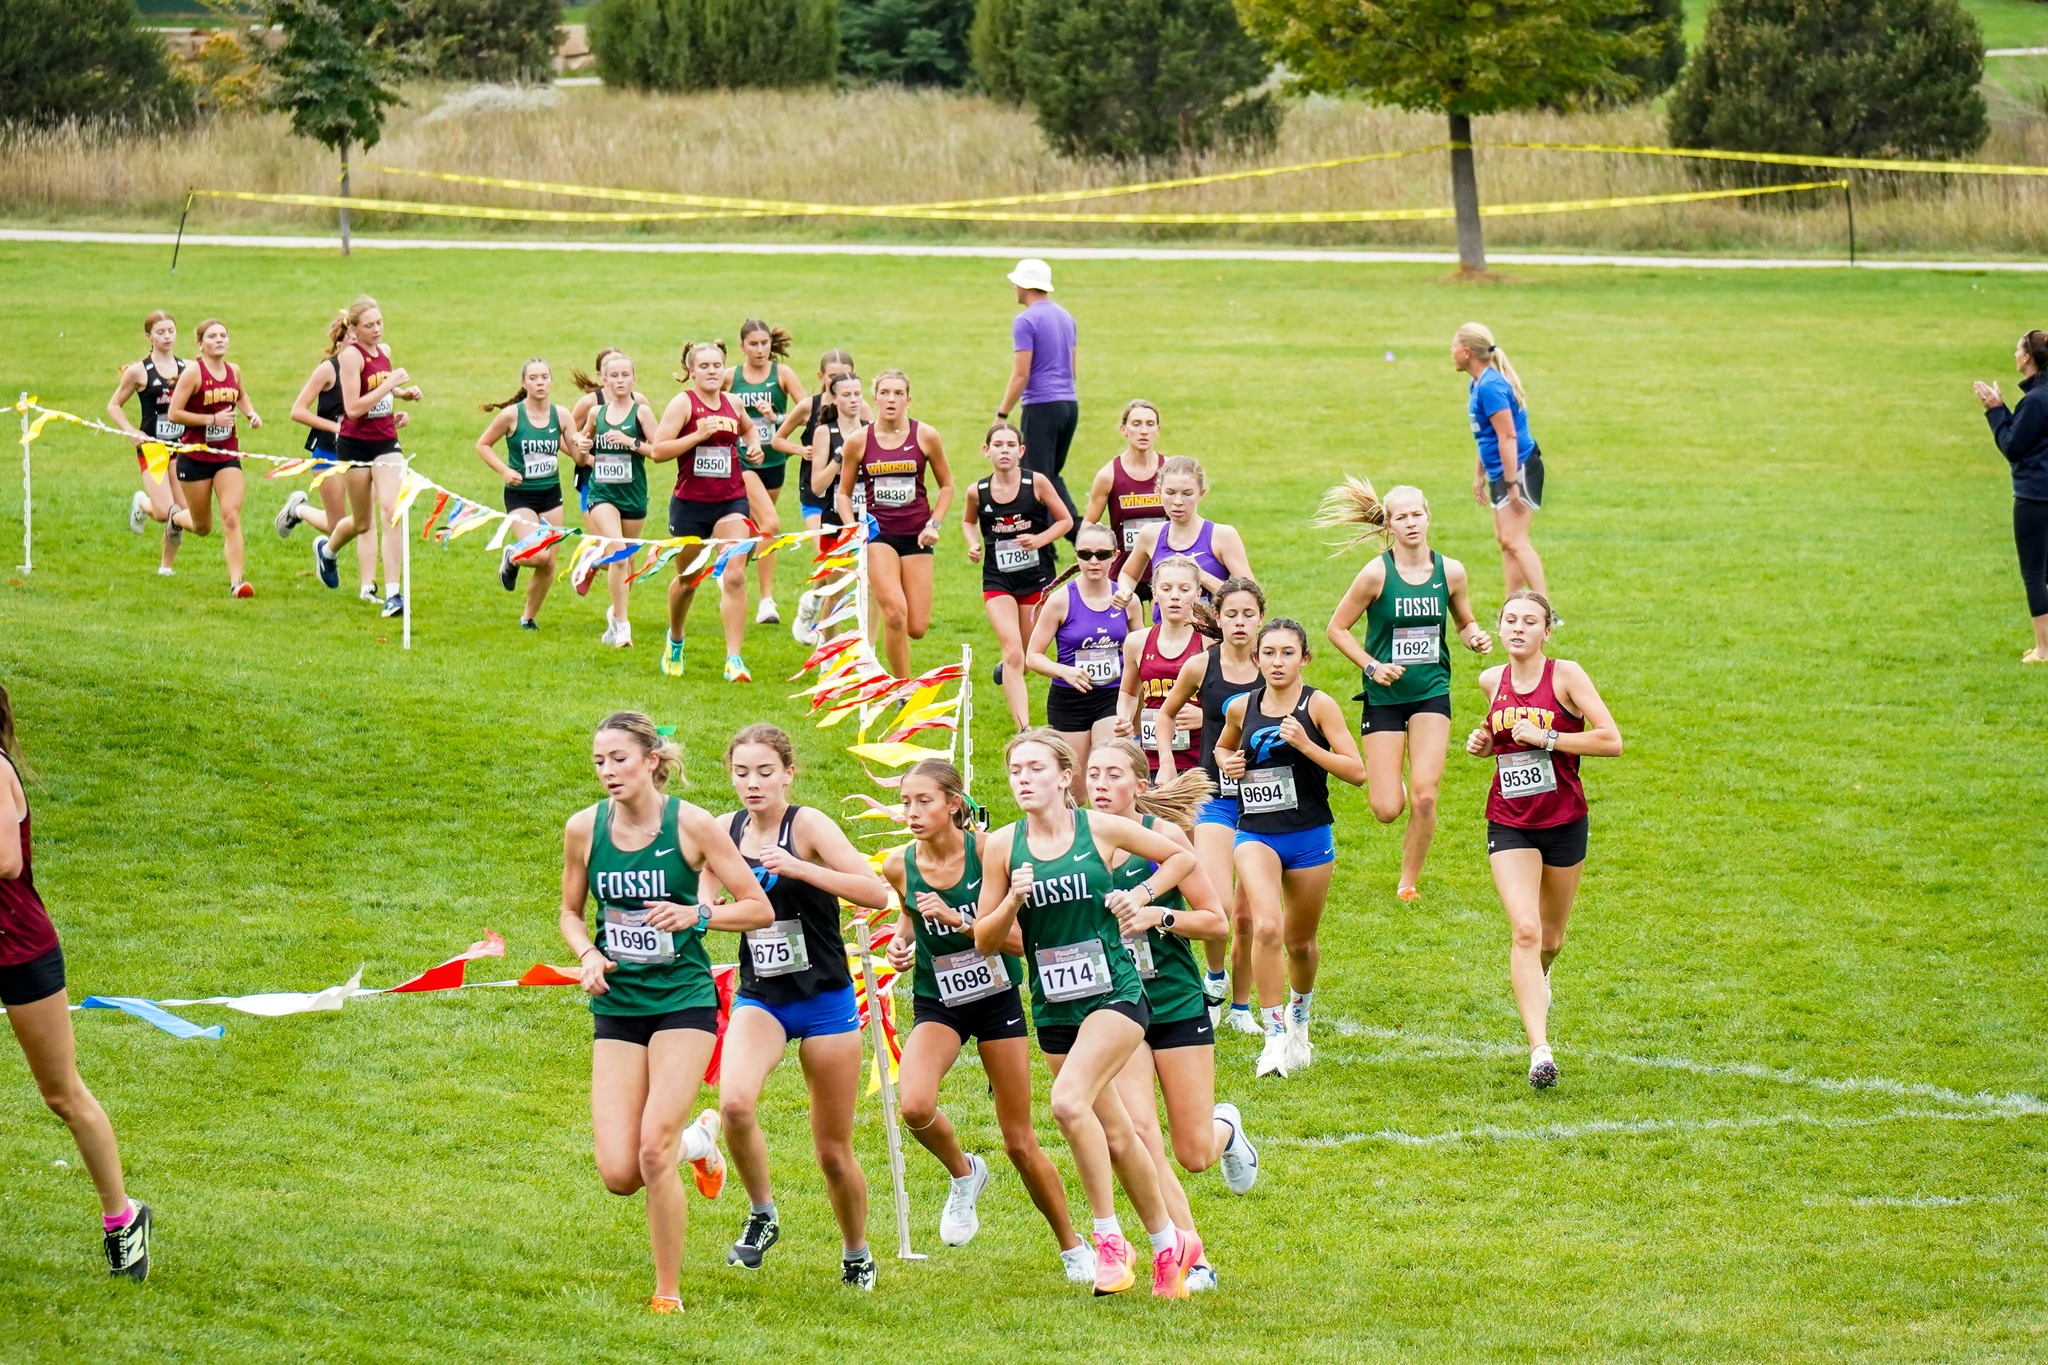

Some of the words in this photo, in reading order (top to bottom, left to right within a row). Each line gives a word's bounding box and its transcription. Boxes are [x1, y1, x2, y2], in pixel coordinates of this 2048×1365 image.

[521, 439, 558, 455] FOSSIL
[527, 461, 551, 474] 1705
[597, 465, 624, 477] 1690
[696, 458, 725, 470] 9550
[867, 460, 917, 475] WINDSOR
[876, 490, 906, 501] 8838
[999, 550, 1030, 566] 1788
[1395, 597, 1442, 617] FOSSIL
[1395, 640, 1429, 656] 1692
[1491, 706, 1555, 735] ROCKY
[1503, 766, 1542, 788] 9538
[1243, 784, 1283, 803] 9694
[597, 869, 672, 899] FOSSIL
[609, 927, 658, 951] 1696
[940, 965, 992, 994] 1698
[1043, 962, 1093, 990] 1714
